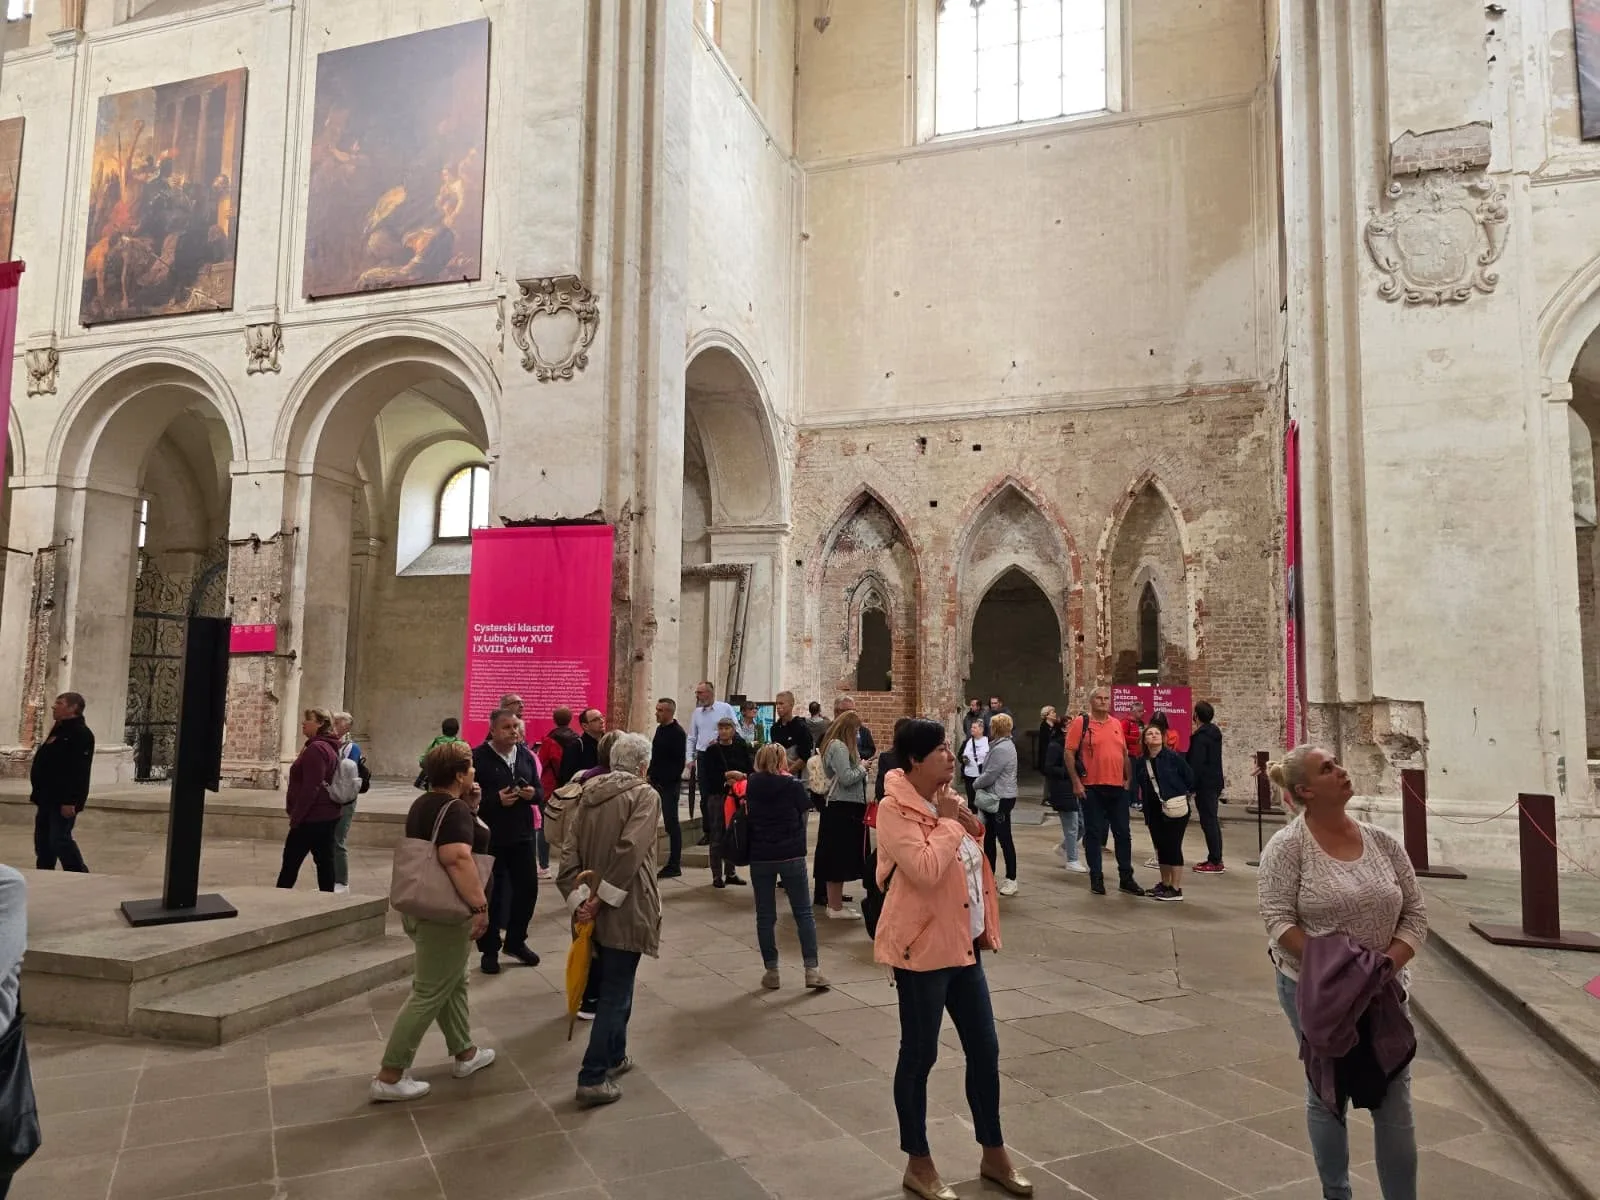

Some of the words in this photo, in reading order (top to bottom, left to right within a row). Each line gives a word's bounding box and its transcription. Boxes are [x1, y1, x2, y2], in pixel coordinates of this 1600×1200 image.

[474, 623, 516, 634] Cysterski
[518, 623, 554, 632] klasztor
[484, 634, 518, 645] Lubiążu
[530, 635, 553, 643] XVII
[477, 645, 504, 653] XVIII
[506, 644, 534, 653] wieku
